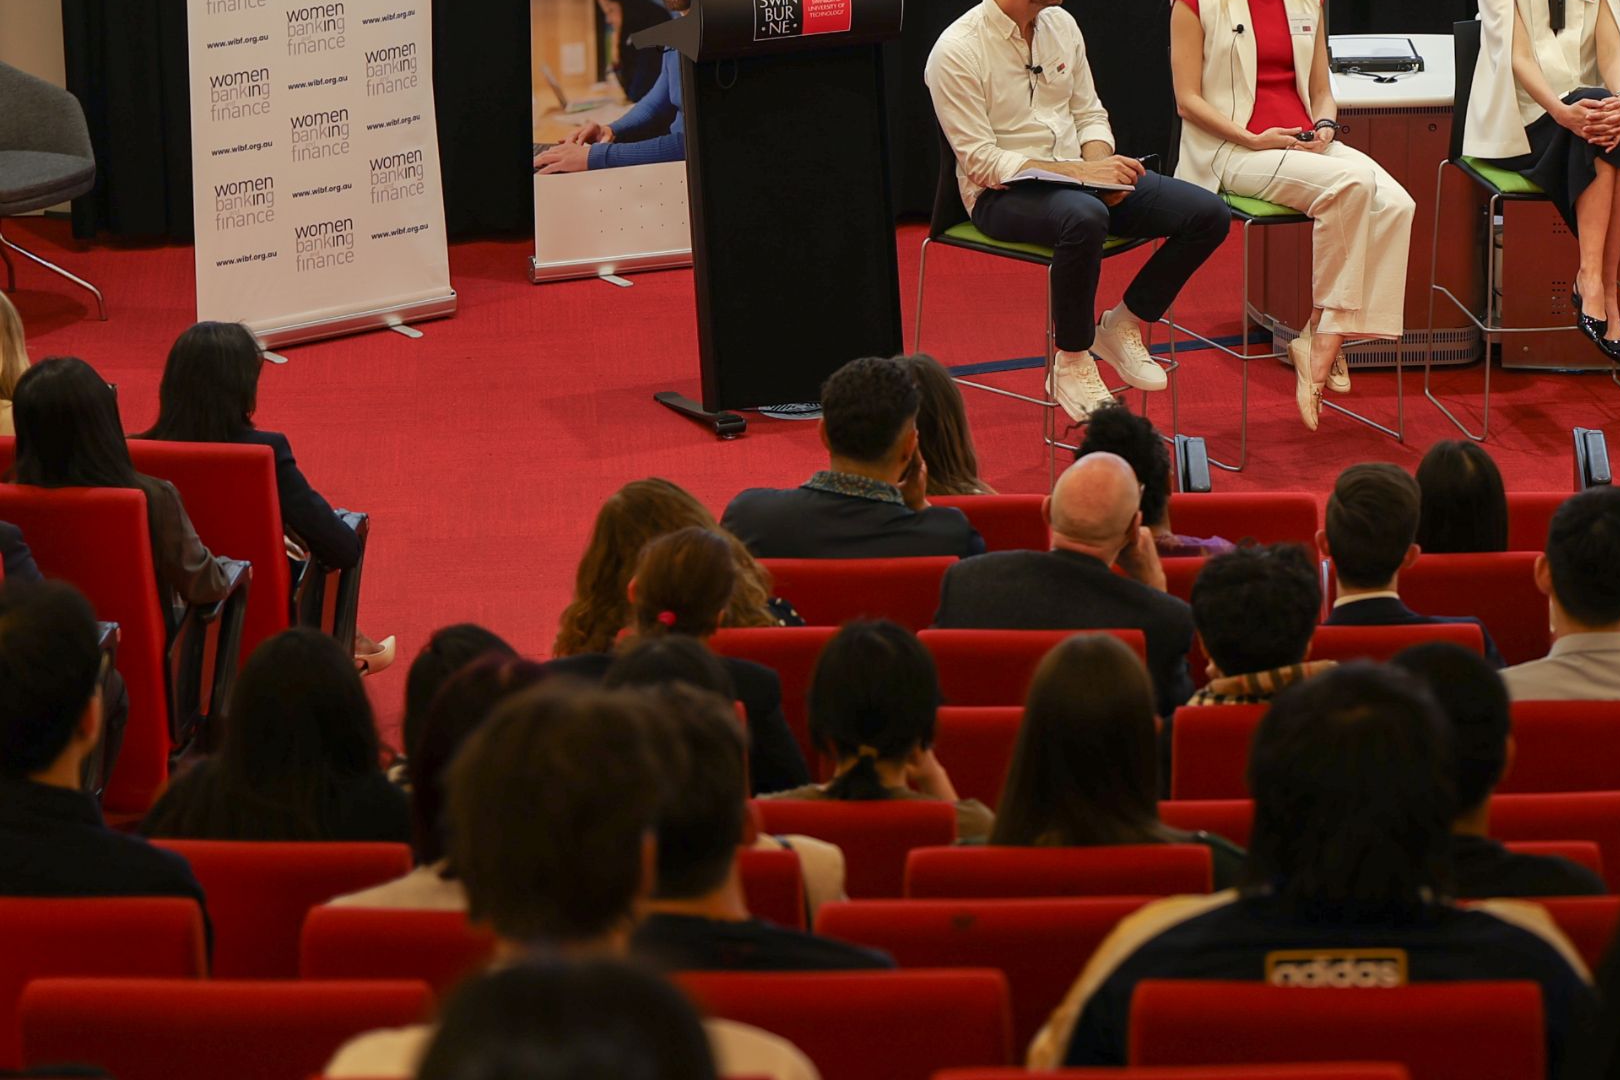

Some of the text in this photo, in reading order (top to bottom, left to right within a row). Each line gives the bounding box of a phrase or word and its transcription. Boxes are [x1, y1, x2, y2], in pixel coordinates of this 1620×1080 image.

[765, 6, 794, 21] BUR
[808, 3, 837, 12] UNIVERSITY
[809, 9, 845, 18] TECHNOLOGY
[295, 217, 353, 239] women
[371, 224, 428, 240] www.wibf.org.au
[296, 231, 354, 253] banking
[296, 249, 354, 272] finance
[1272, 956, 1399, 988] adidas
